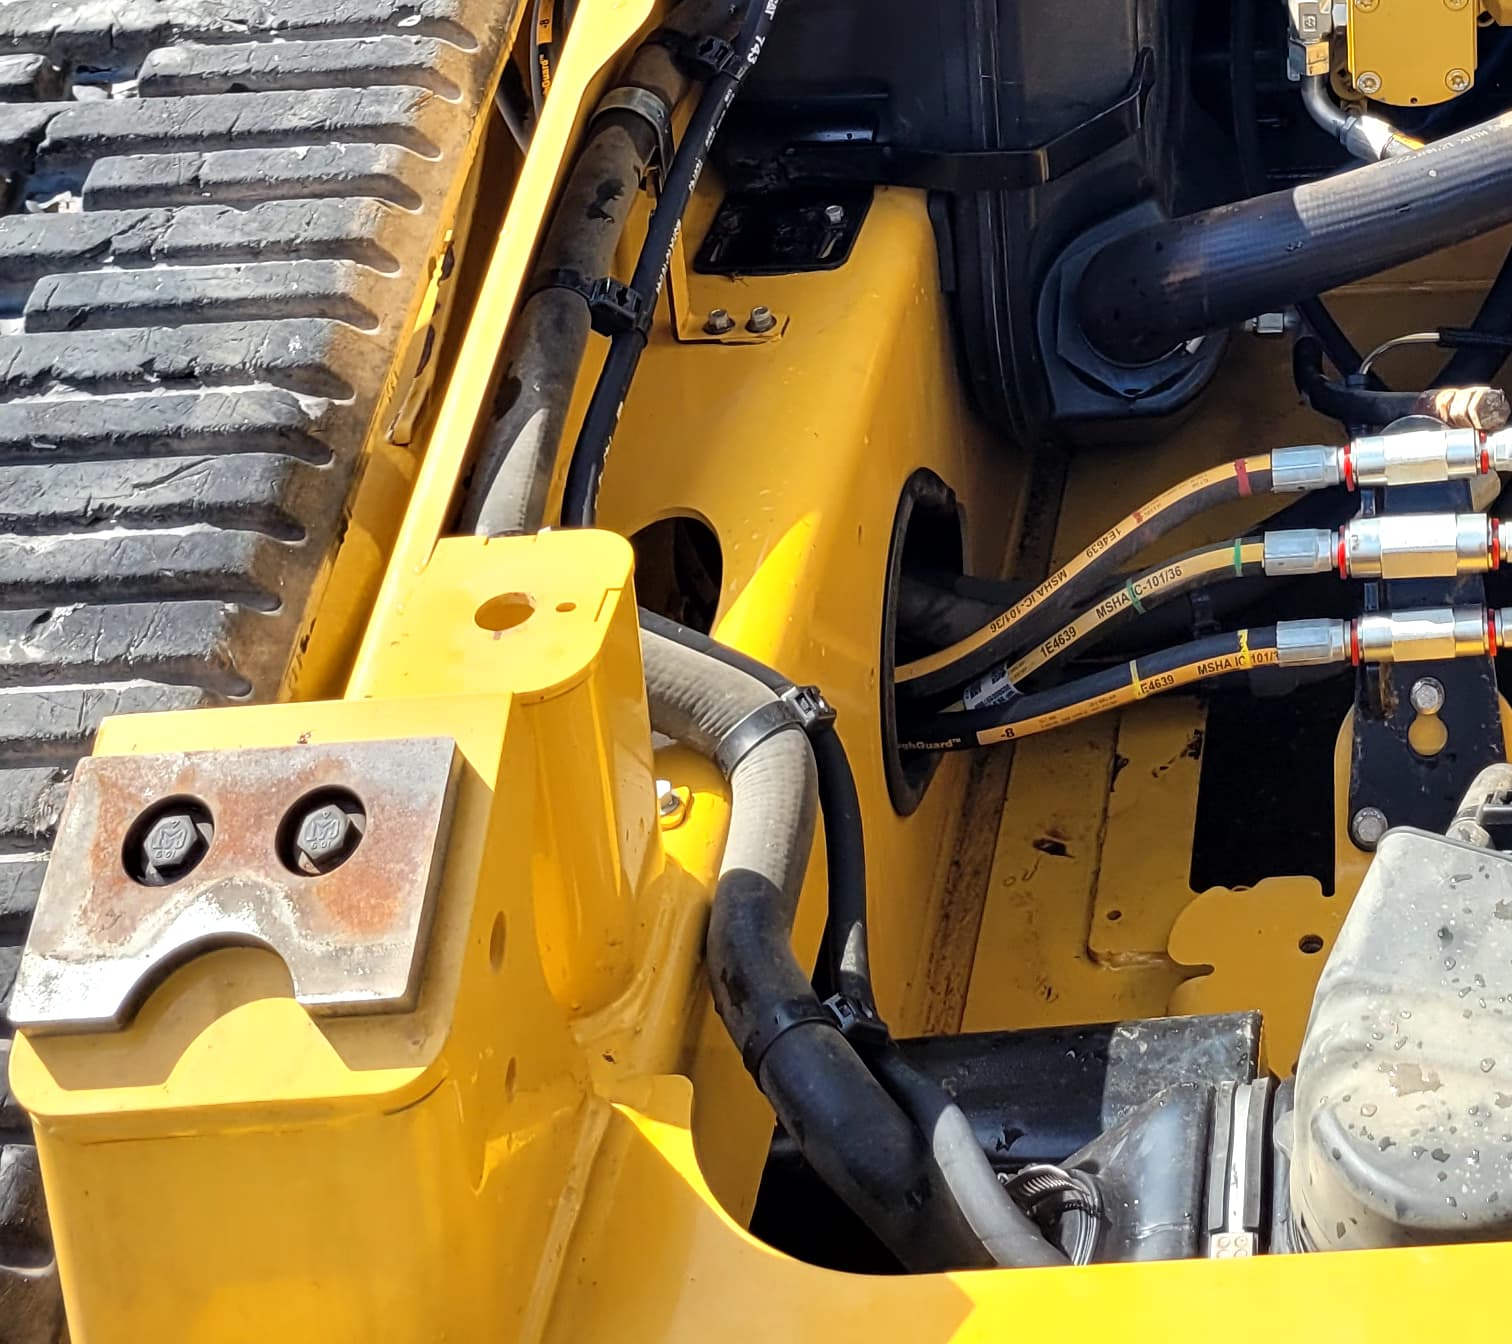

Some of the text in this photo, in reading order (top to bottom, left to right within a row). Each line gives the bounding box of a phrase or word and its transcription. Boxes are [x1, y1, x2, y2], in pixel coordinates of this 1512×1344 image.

[746, 34, 767, 65] 743
[989, 526, 1122, 634] 1E4639 MSHA IC-101/36
[1039, 626, 1078, 659] 1E4639
[1095, 592, 1131, 620] MSHA
[1138, 674, 1175, 696] E4639
[1197, 657, 1233, 676] MSHA
[1000, 727, 1016, 740] -8
